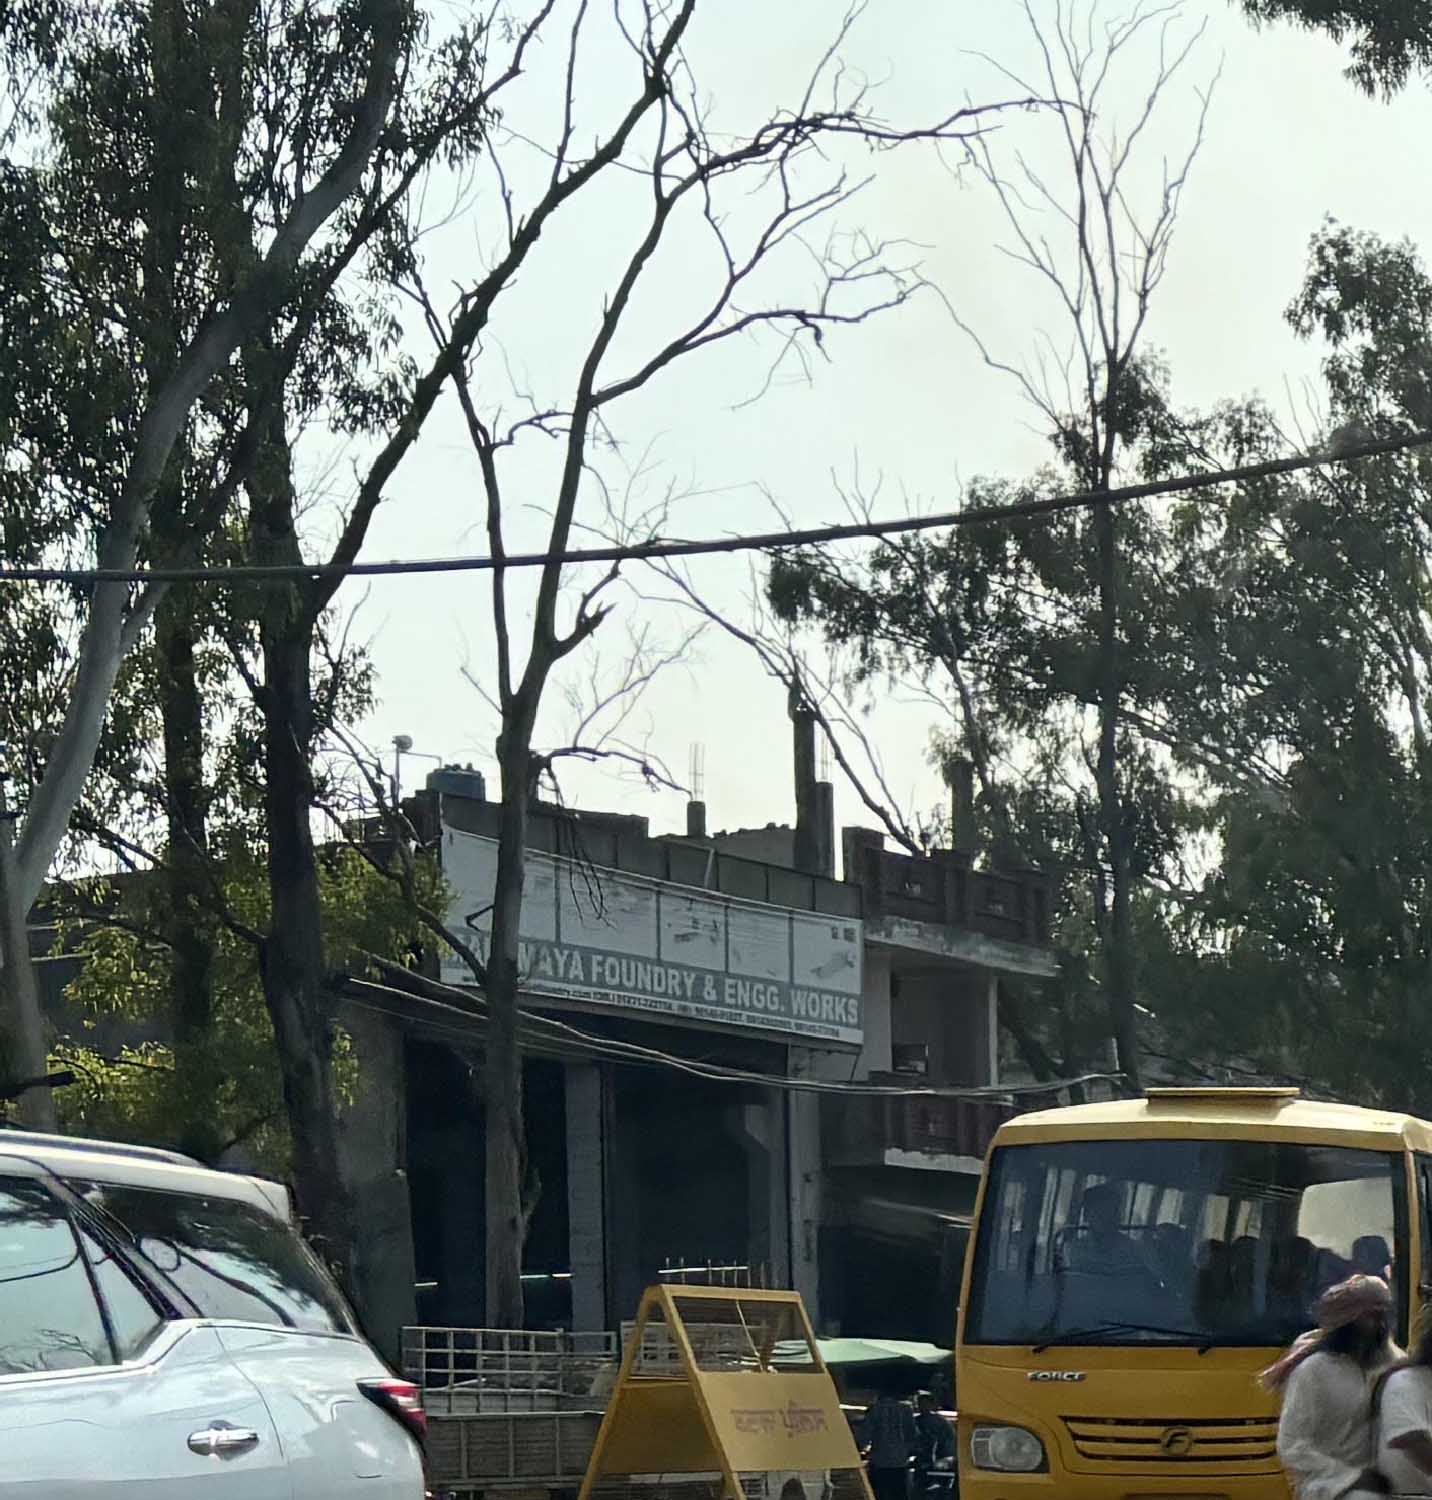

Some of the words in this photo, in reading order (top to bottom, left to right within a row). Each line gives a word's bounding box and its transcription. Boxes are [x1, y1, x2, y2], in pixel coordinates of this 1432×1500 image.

[591, 954, 697, 999] FOUNDRY
[703, 976, 718, 1001] &
[724, 977, 785, 1013] ENGG.
[790, 989, 859, 1024] WORKS
